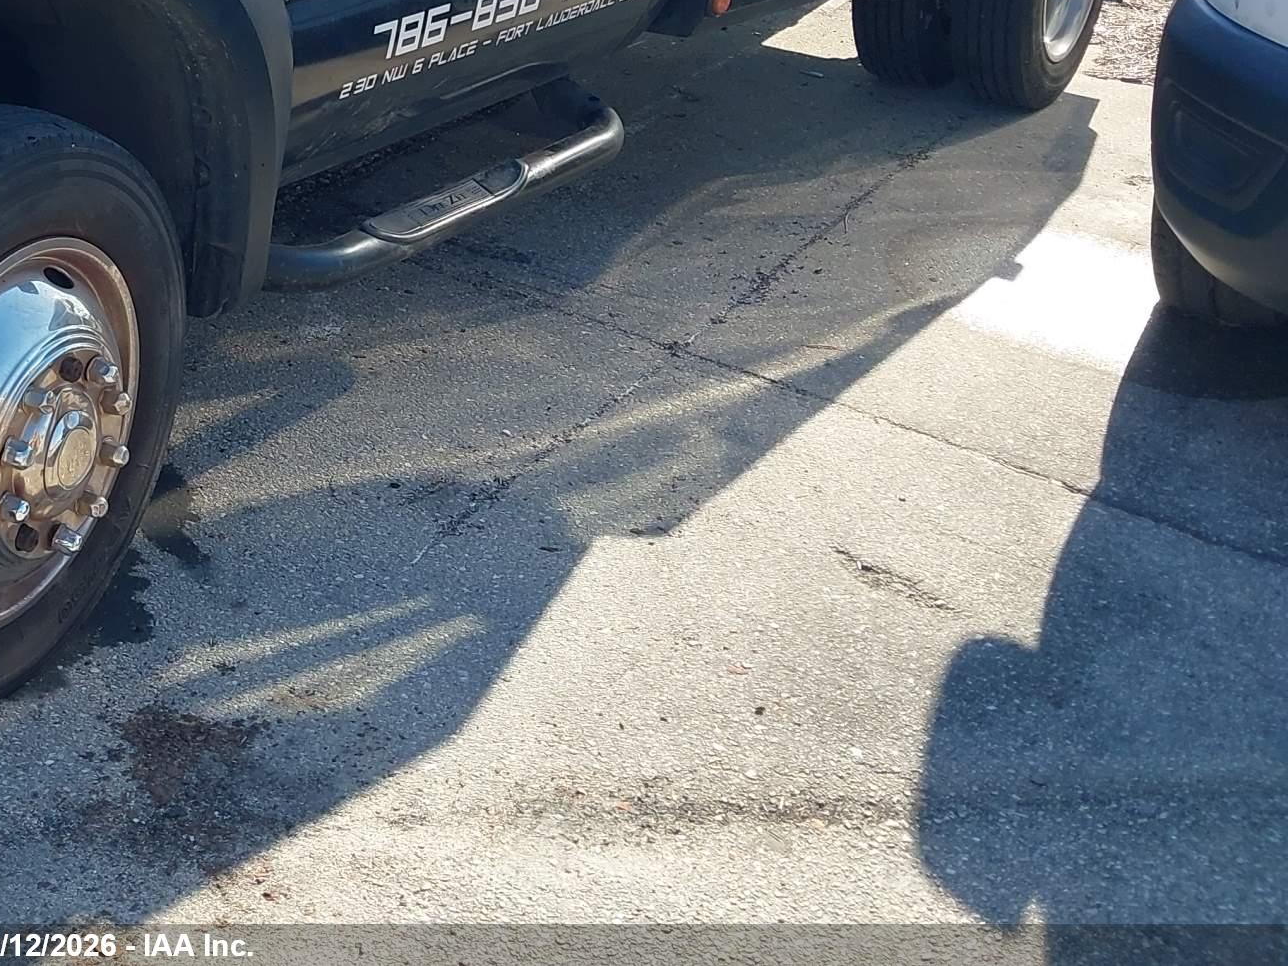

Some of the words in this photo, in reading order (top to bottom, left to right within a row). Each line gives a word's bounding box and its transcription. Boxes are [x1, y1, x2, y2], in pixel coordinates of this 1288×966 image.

[381, 63, 409, 85] NW
[412, 57, 425, 75] 6
[428, 39, 479, 70] PLACE
[496, 20, 533, 46] FORT
